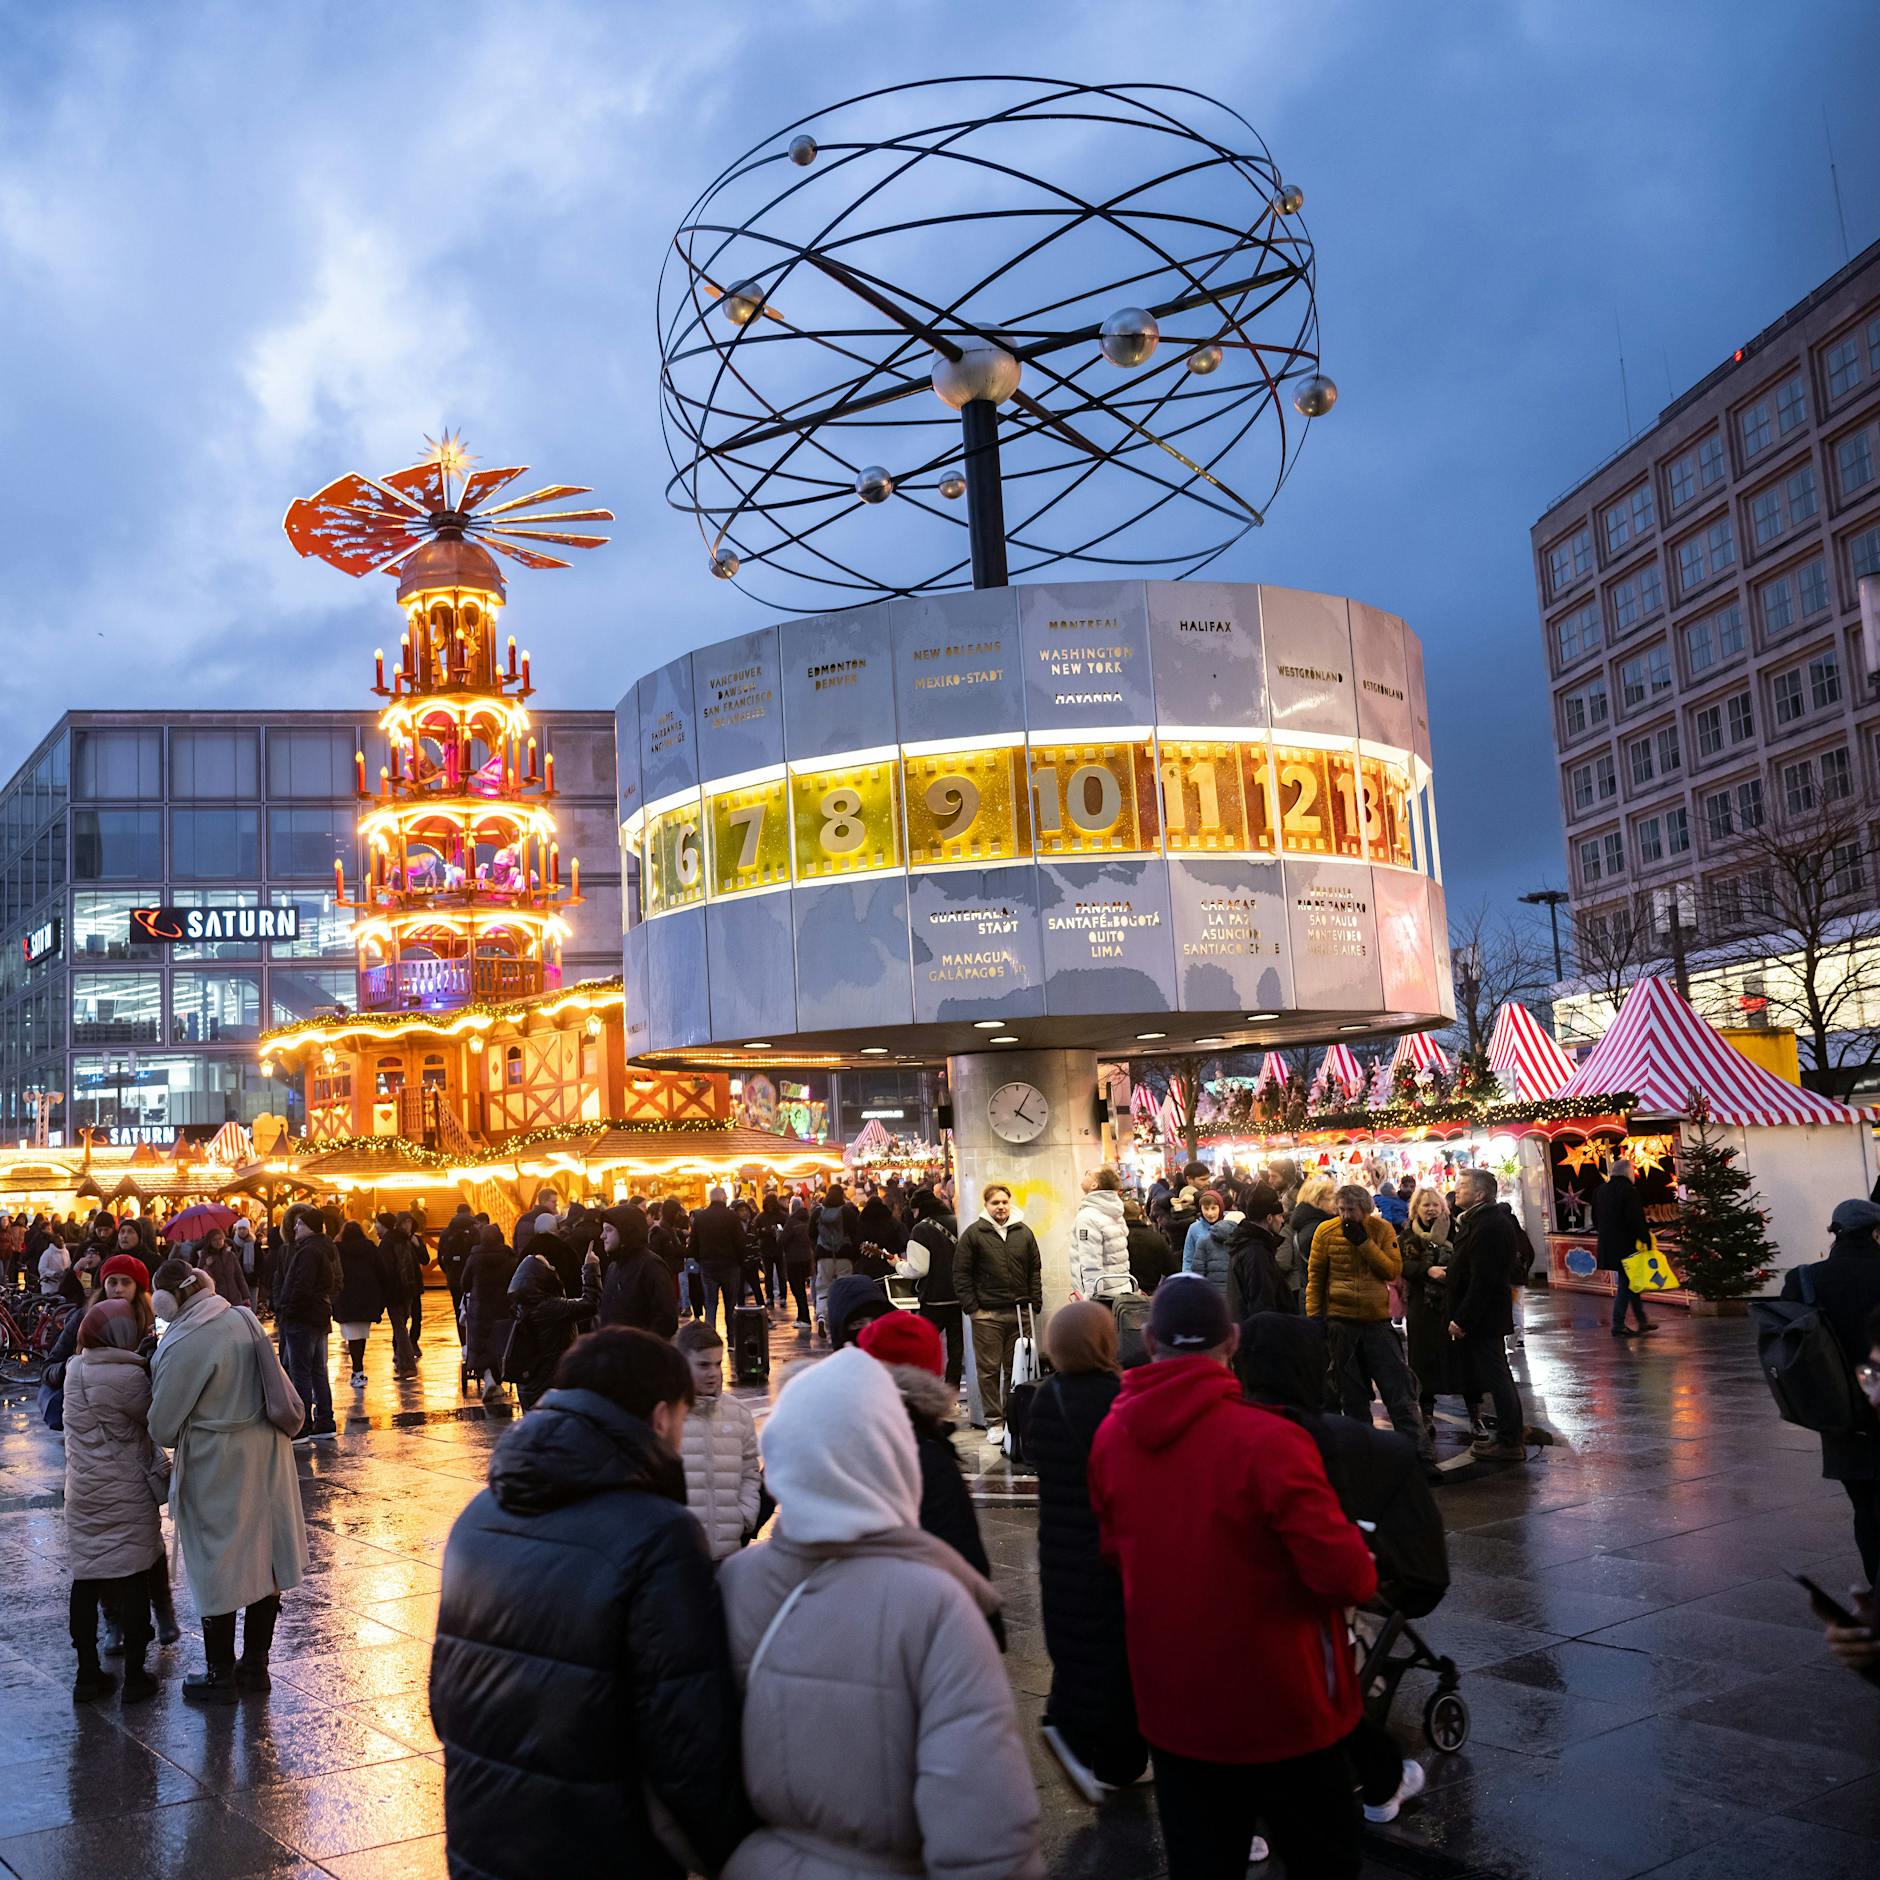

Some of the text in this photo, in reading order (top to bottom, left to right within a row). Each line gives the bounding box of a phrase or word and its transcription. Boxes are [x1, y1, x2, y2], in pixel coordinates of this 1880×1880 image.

[1048, 618, 1120, 632] MONTREAL
[1180, 620, 1232, 633] HALIFAX
[913, 640, 1001, 661] NEW ORLEANS
[1040, 646, 1134, 662] WASHINGTON
[710, 665, 763, 689] VANCOUVER
[808, 658, 866, 678] EDMONTON
[1051, 661, 1122, 676] NEW YORK
[1277, 665, 1343, 683] WESTGRÖNLAND
[914, 669, 1004, 690] MEXIKO-STADT
[1055, 691, 1123, 705] HAVANNA
[1031, 764, 1122, 833] 10
[1153, 762, 1220, 829] 11
[1253, 764, 1322, 832] 12
[924, 774, 980, 843] 9
[1335, 772, 1382, 841] 13
[819, 787, 866, 854] 8
[729, 802, 768, 869] 7
[675, 823, 699, 886] 6
[1075, 901, 1132, 915] PANAMA
[1297, 899, 1312, 911] RIO
[1328, 901, 1366, 913] JANEIRO
[187, 909, 296, 938] SATURN
[978, 920, 1018, 935] STADT
[1208, 913, 1224, 926] LA
[1088, 930, 1125, 943] QUITO
[942, 950, 1011, 967] MANAGUA
[1091, 945, 1124, 958] LIMA
[928, 965, 1005, 982] GALÁPAGOS
[109, 1126, 175, 1145] SATURN
